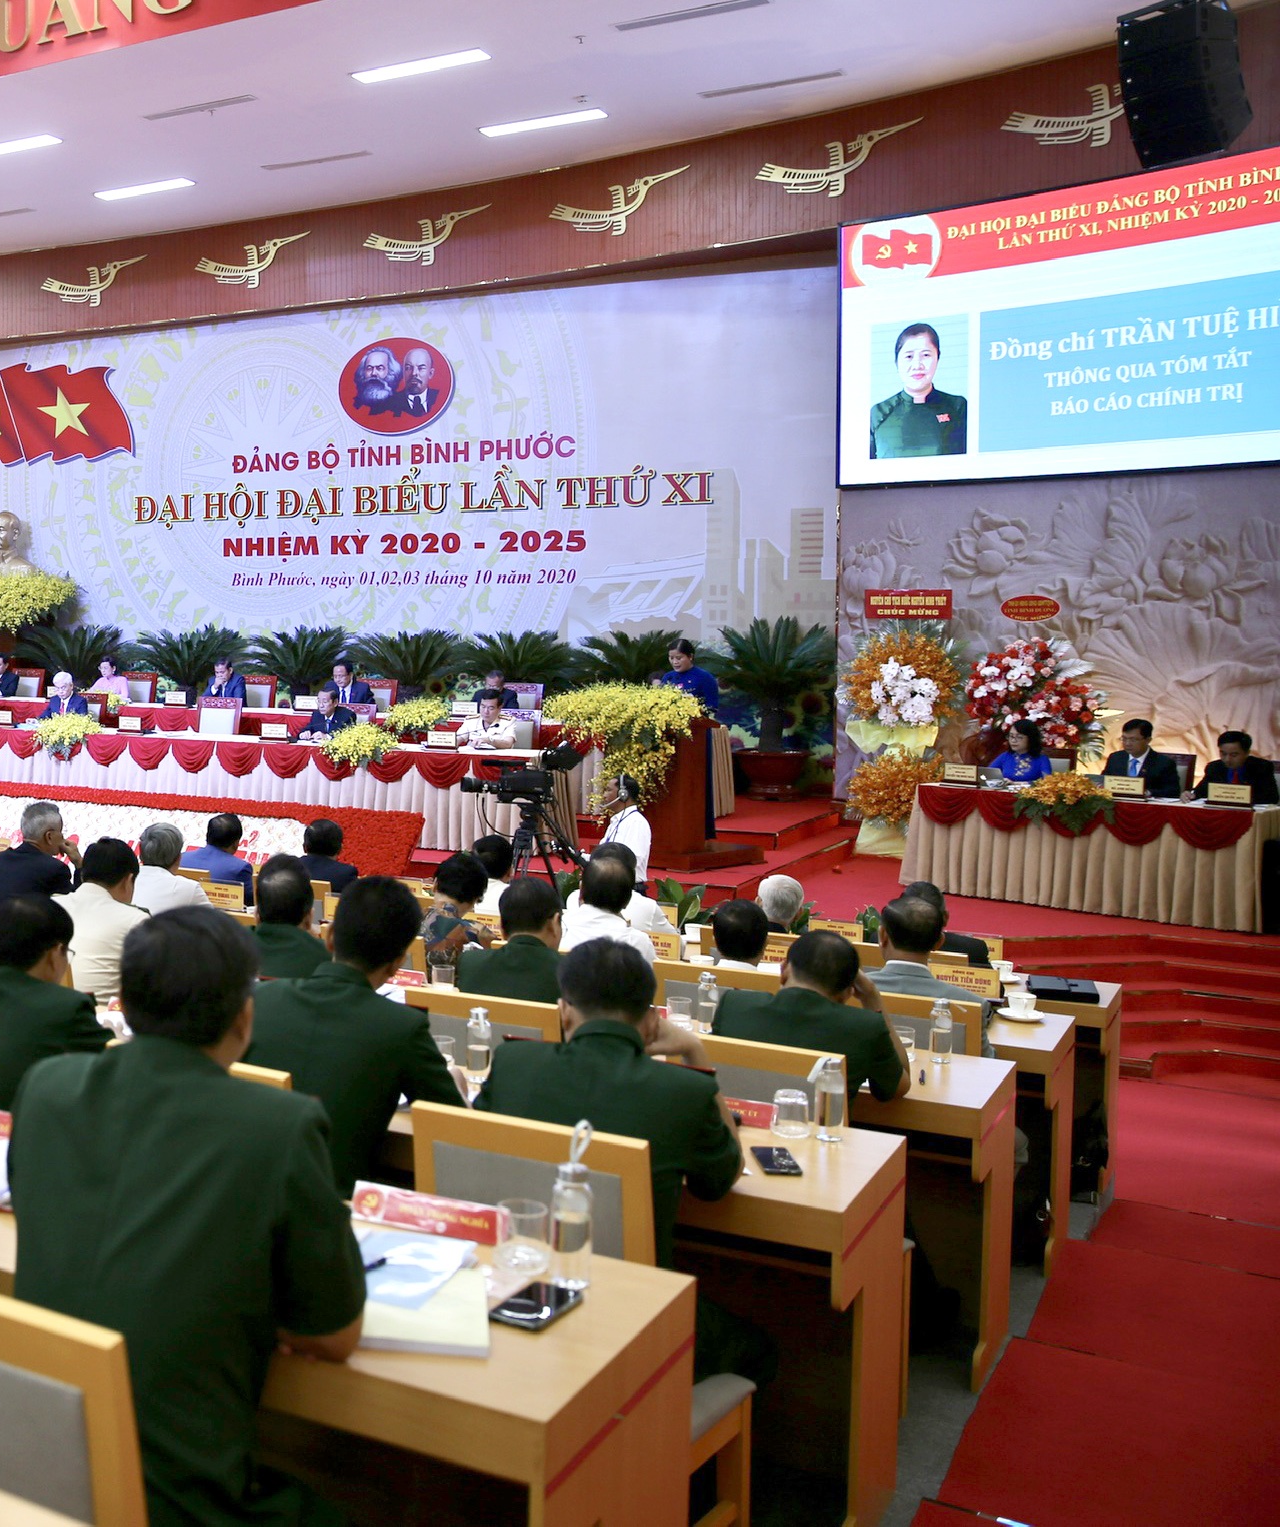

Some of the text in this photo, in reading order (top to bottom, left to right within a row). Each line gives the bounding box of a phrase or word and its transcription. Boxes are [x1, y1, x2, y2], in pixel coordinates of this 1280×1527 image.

[947, 223, 976, 240] ĐẠI
[980, 217, 1012, 235] HỘI
[1015, 211, 1047, 229] ĐẠI
[1096, 191, 1149, 215] ĐẢNG
[1154, 185, 1180, 205] BỘ
[1184, 176, 1233, 198] TỈNH
[1037, 223, 1075, 244] THỨ
[1079, 222, 1103, 237] XI,
[1107, 209, 1170, 229] NHIỆM
[1208, 195, 1247, 215] 2020
[989, 300, 1280, 361] Đồng chí TRẦN TUỆ HI
[1044, 346, 1252, 388] THÔNG QUA TÓM TẮT
[1050, 382, 1243, 416] BÁO CÁO CHÍNH TRỊ
[232, 433, 576, 474] ĐẢNG BỘ TỈNH BÌNH PHƯỚC
[134, 464, 713, 530] ĐẠI HỘI ĐẠI BIỂU LẦN THỨ XI
[223, 532, 320, 563] NHIỆM
[330, 529, 369, 555] KỲ
[381, 532, 461, 554] 2020
[499, 530, 587, 553] 2025
[231, 568, 577, 588] Bình Phước, ngày 01,02,03 tháng 10 năm 2020
[877, 606, 905, 615] CHÚC
